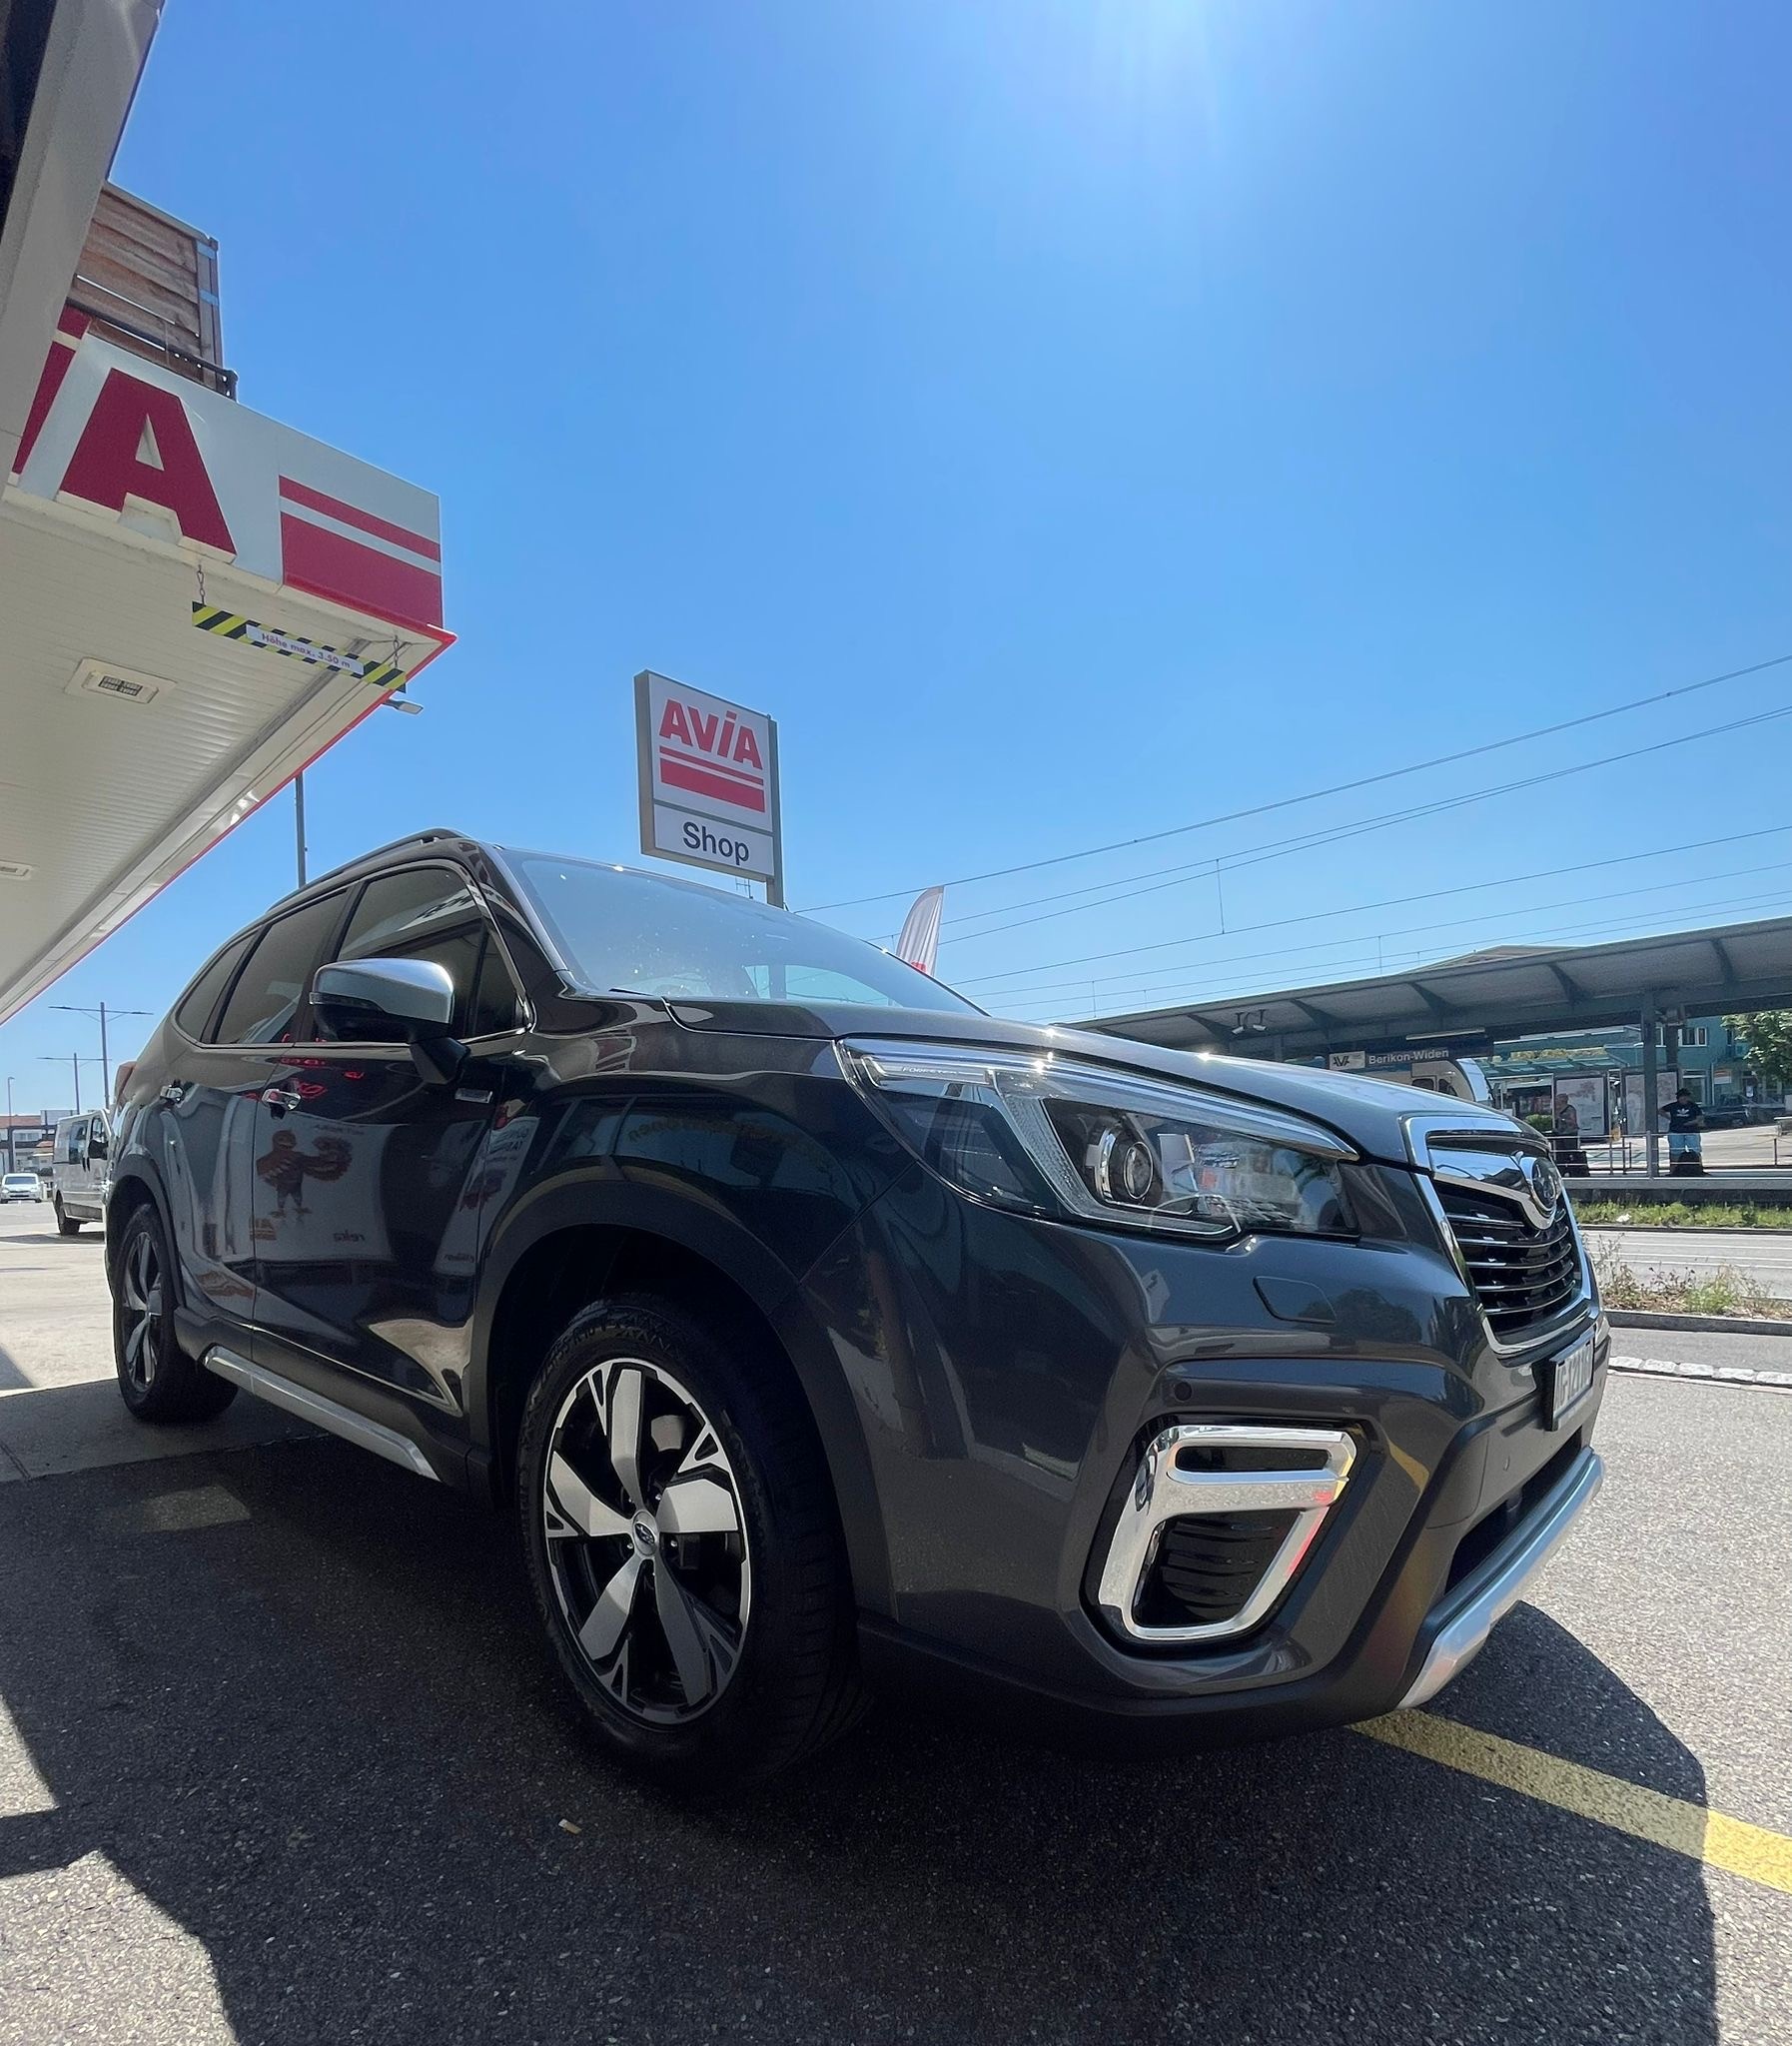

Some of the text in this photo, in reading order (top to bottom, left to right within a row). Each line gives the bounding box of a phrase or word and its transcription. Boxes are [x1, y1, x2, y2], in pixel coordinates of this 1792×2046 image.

[262, 632, 288, 648] Höhe
[290, 643, 316, 657] max.
[682, 821, 750, 865] Shop
[1368, 1049, 1449, 1065] Berikon-Widen
